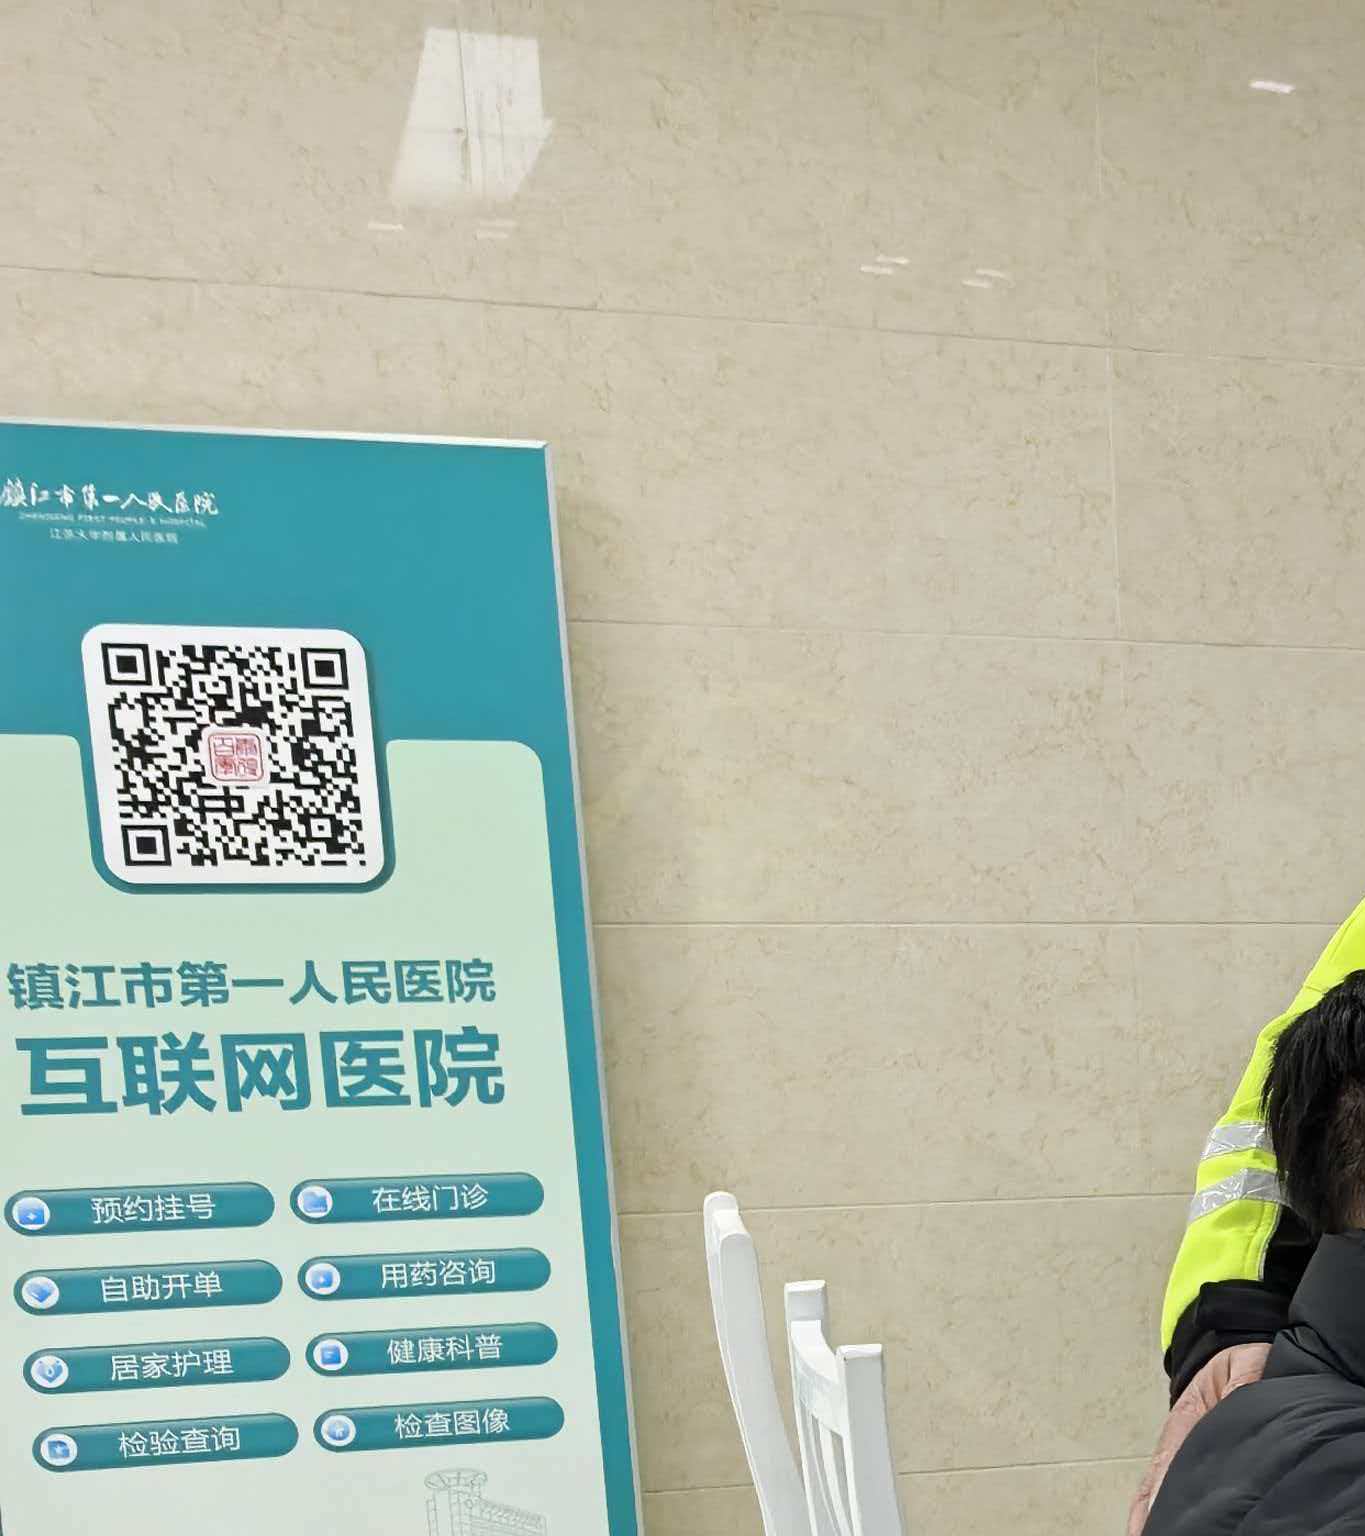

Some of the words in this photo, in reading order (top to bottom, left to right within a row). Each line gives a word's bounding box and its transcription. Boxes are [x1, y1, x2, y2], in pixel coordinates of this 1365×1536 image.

[6, 957, 497, 1010] 镇江市第一人民医院
[15, 1025, 506, 1117] 互联网医院
[91, 1193, 217, 1225] 预约挂号
[371, 1183, 489, 1214] 在线门诊
[100, 1271, 224, 1304] 自助开单
[380, 1257, 497, 1289] 用药咨询
[386, 1333, 504, 1364] 健康科普
[110, 1348, 234, 1382] 居家护理
[394, 1408, 511, 1440] 检查图像
[118, 1425, 242, 1458] 检验查询
